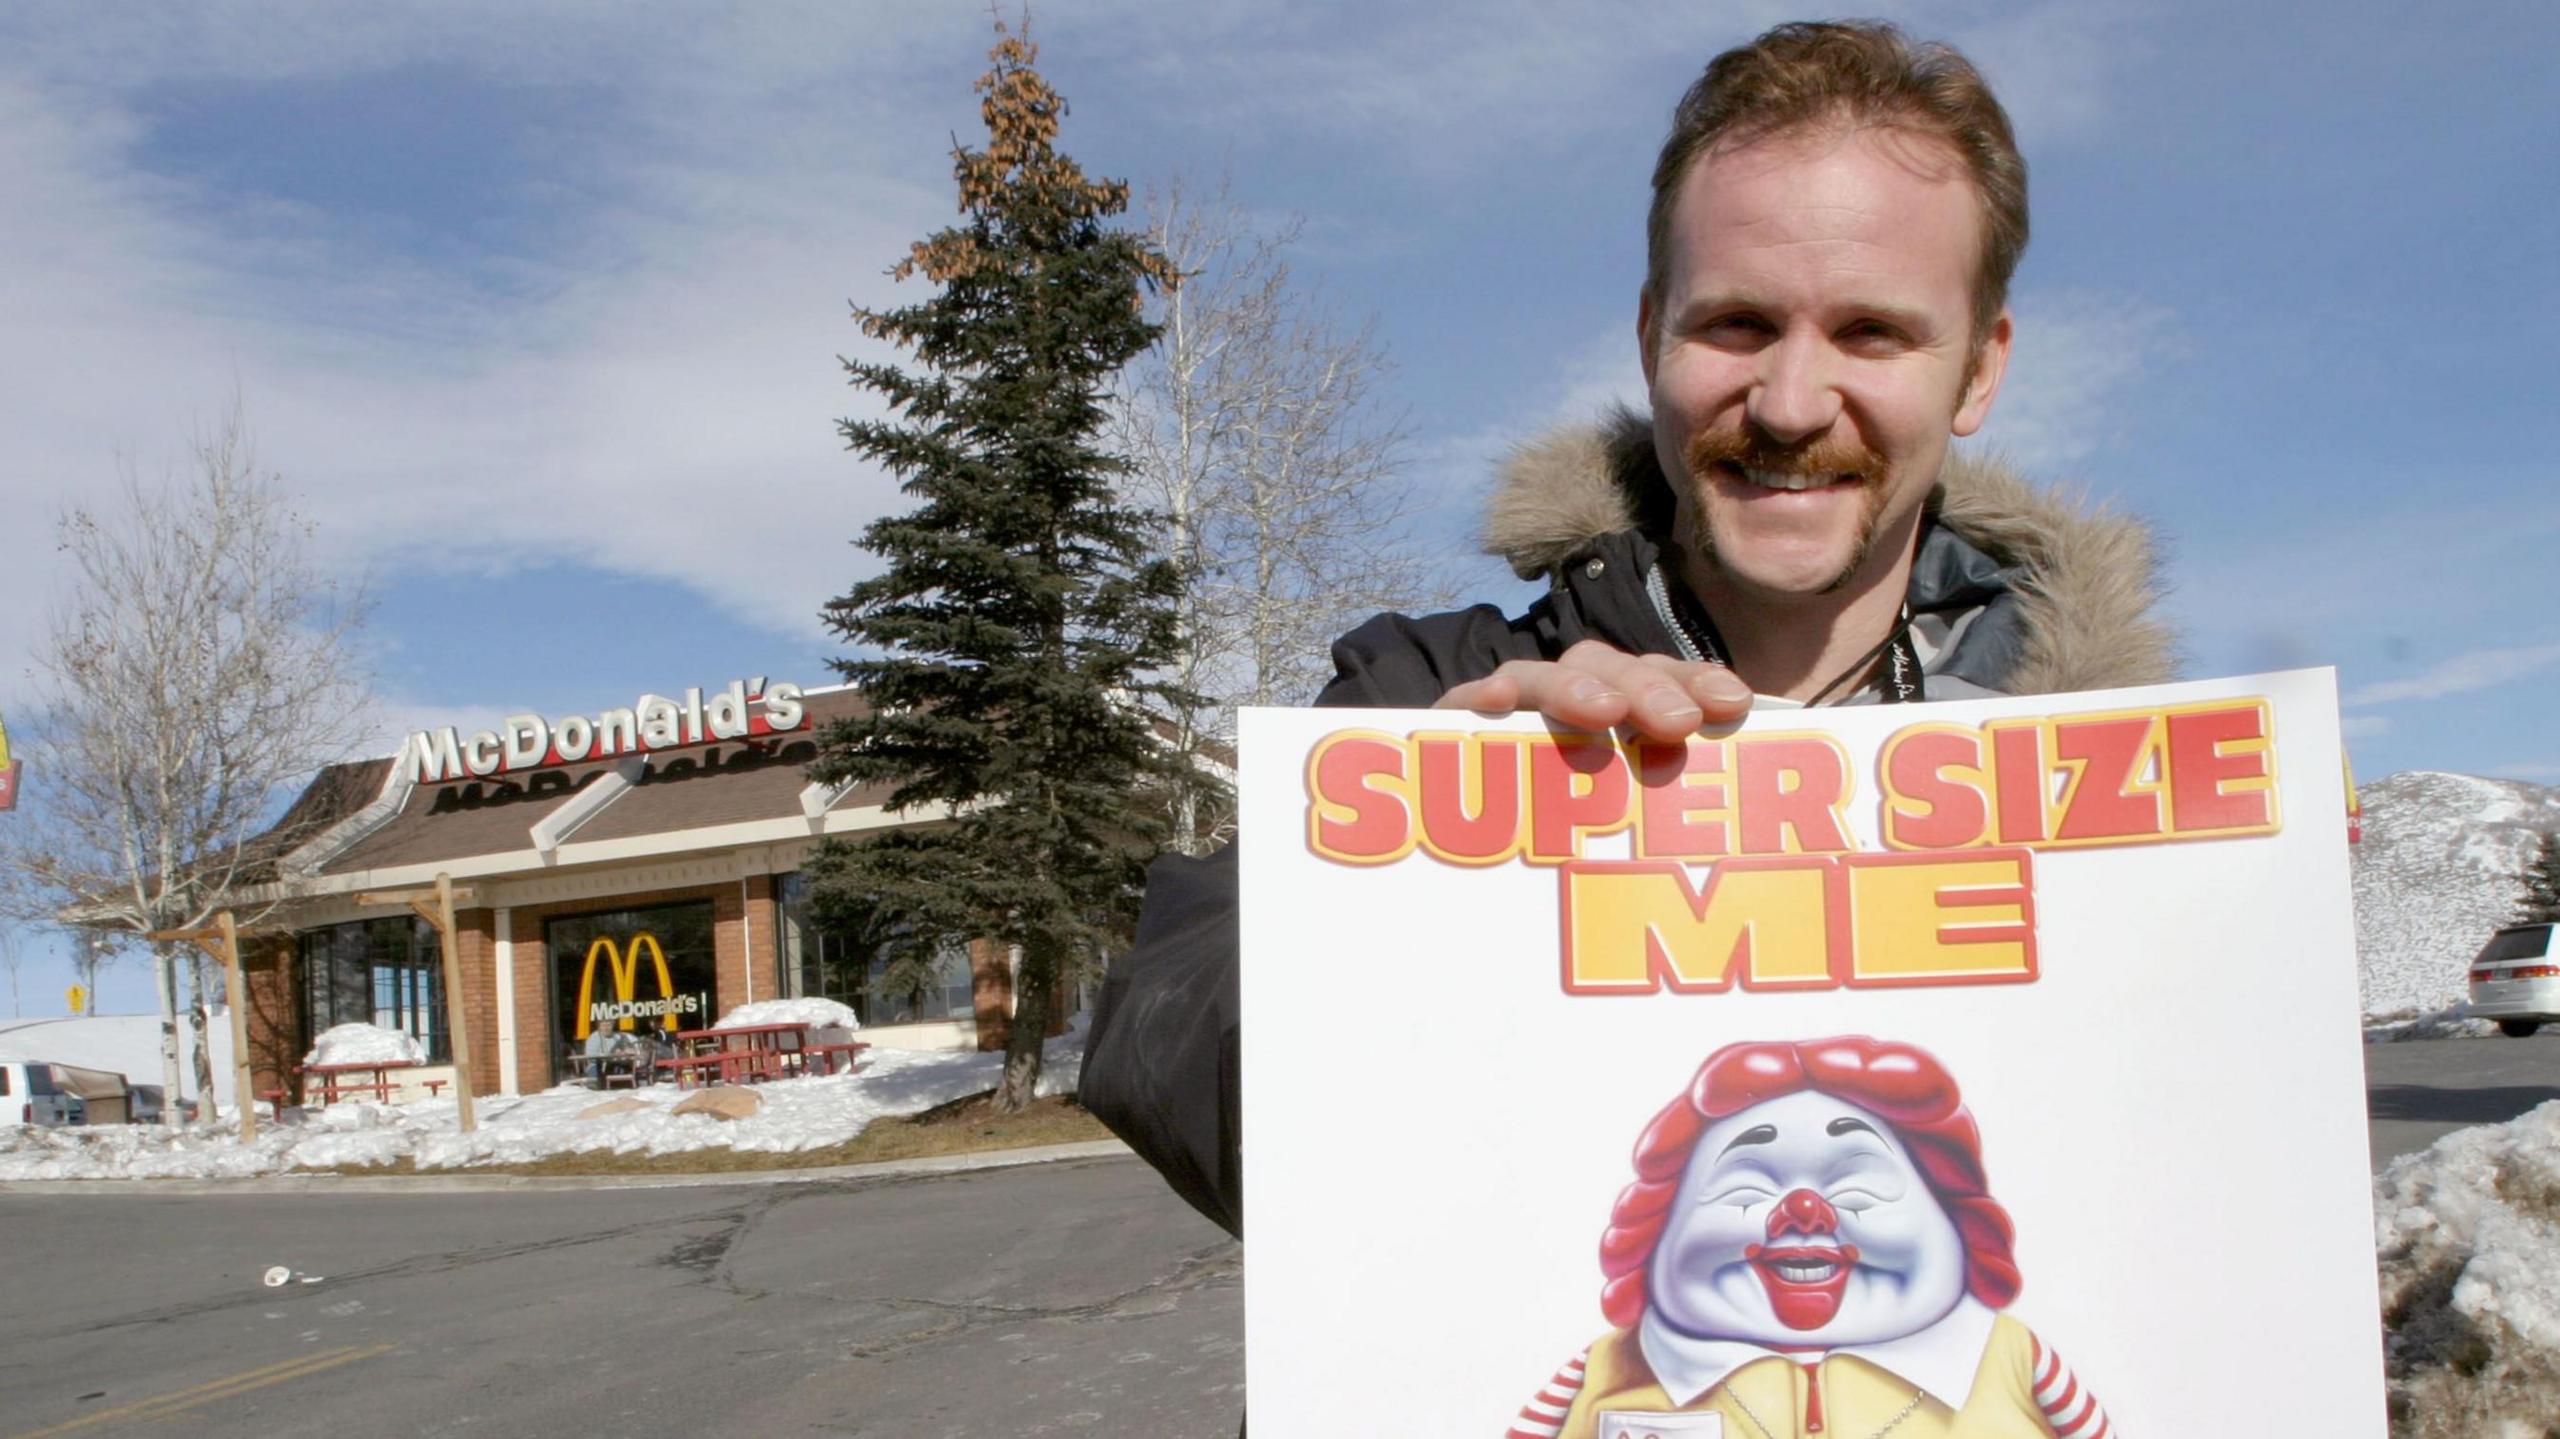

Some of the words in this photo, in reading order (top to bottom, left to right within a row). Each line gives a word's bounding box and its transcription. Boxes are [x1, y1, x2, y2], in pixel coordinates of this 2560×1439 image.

[407, 676, 804, 783] McDonald's
[1305, 729, 1862, 867] SUPER
[1876, 695, 2282, 853] SIZE
[1561, 847, 2042, 995] ME
[590, 993, 698, 1022] McDonald's
